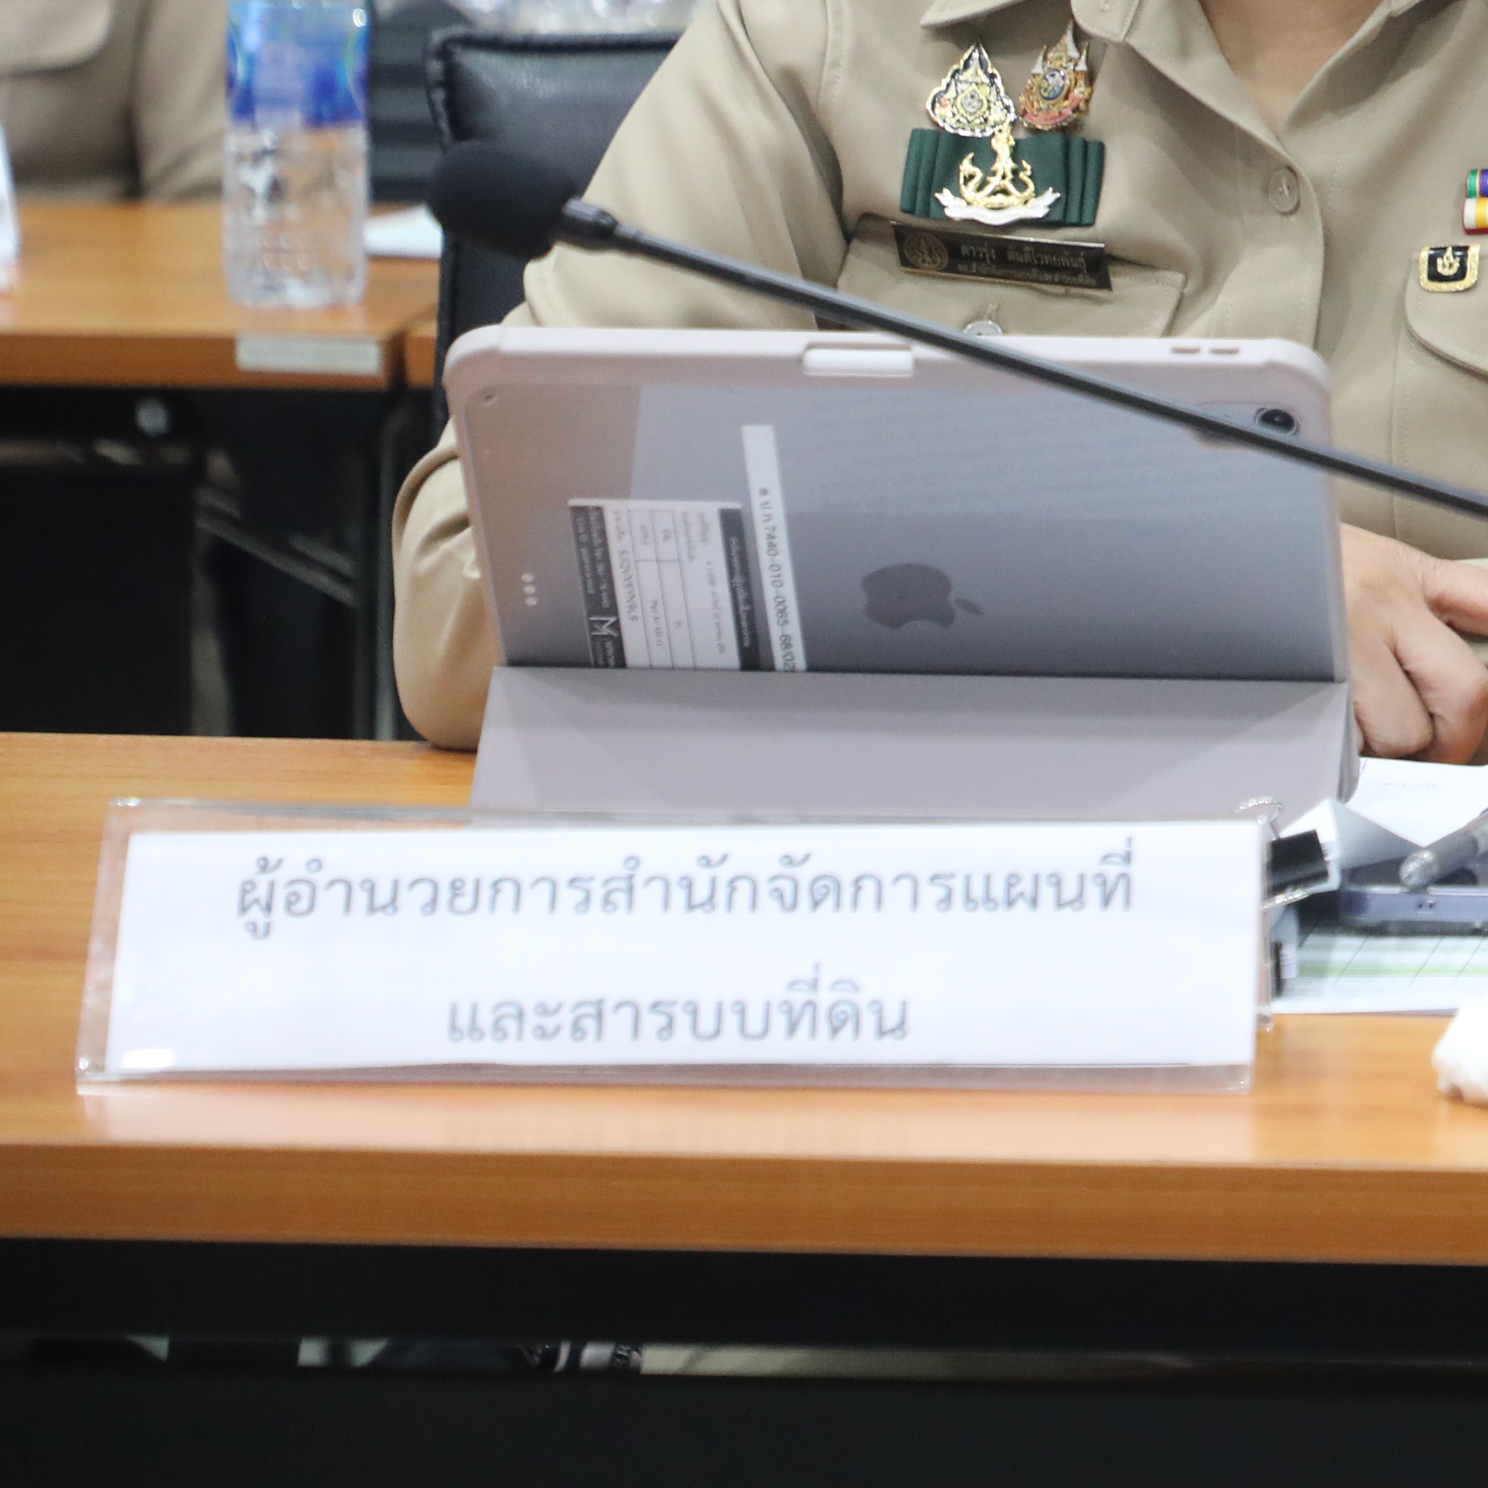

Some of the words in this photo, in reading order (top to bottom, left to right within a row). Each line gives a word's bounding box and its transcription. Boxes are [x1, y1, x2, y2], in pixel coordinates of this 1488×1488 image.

[236, 837, 1134, 940] ผู้อำนวยการสำนักจัดการแผนที่
[446, 962, 910, 1043] และสารบบที่ดิน
